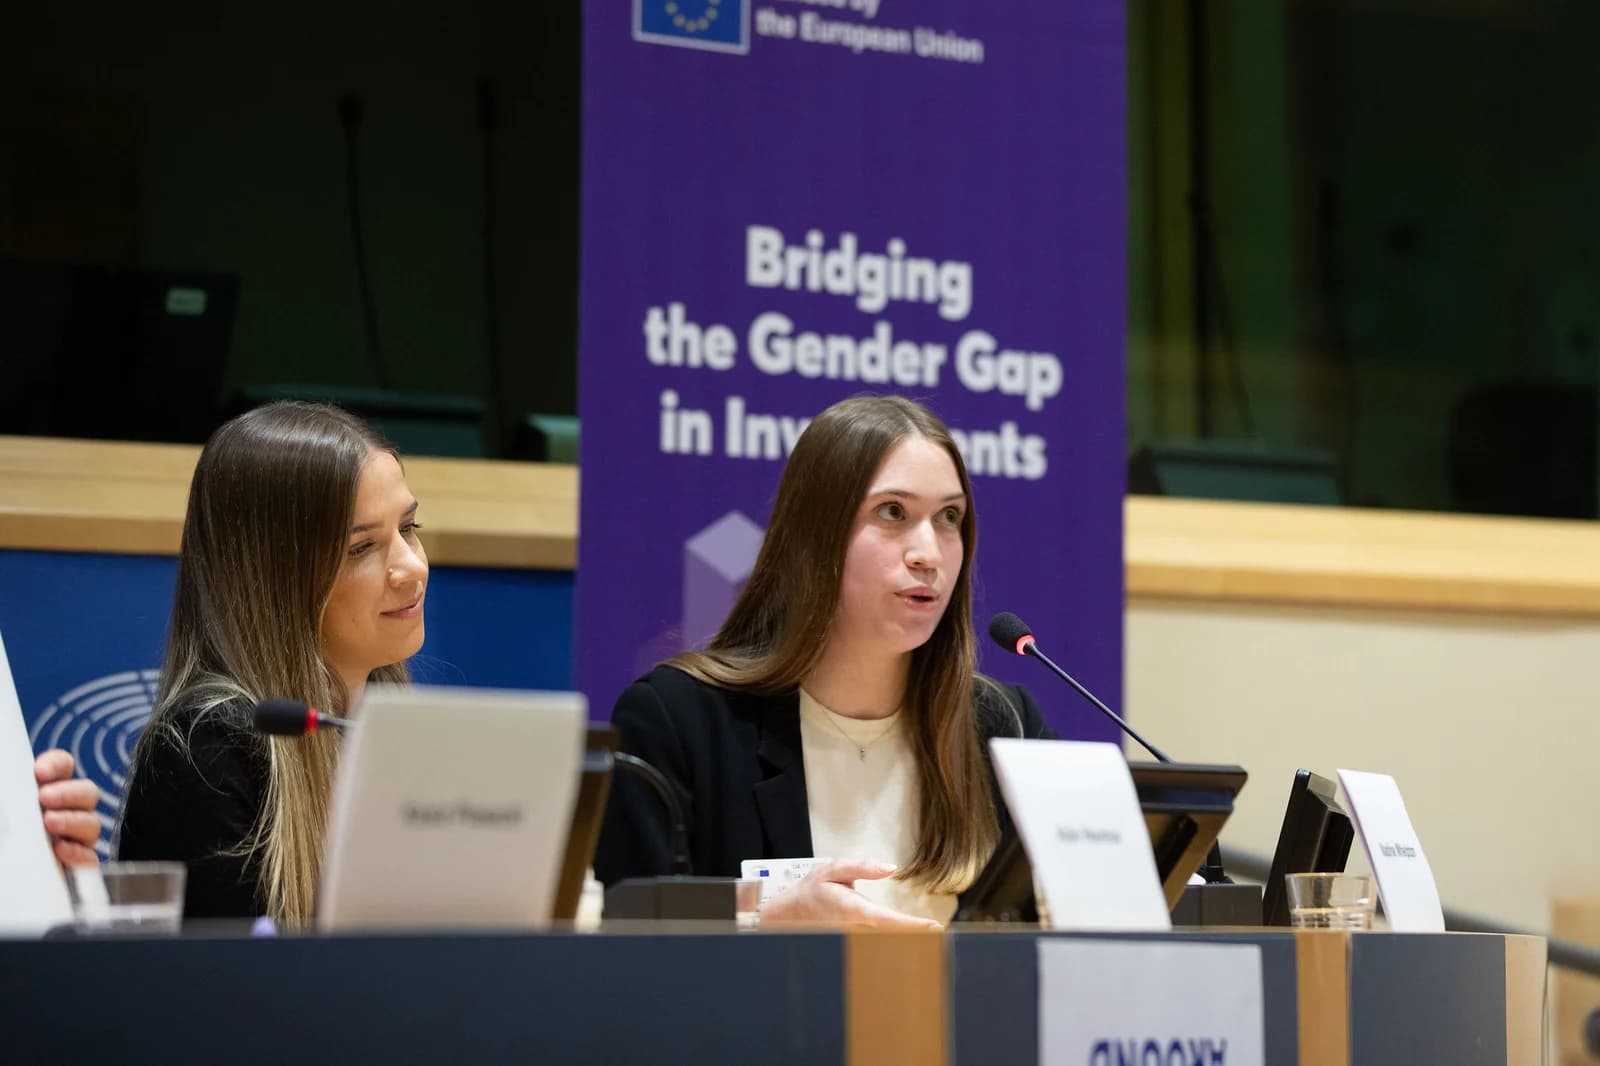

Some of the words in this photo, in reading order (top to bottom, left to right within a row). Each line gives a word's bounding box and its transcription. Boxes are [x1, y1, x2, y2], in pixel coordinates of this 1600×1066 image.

[756, 8, 797, 39] the
[801, 12, 912, 54] European
[914, 27, 985, 64] Union
[746, 225, 973, 321] Bridging
[644, 303, 737, 370] the
[748, 312, 947, 387] Gender
[955, 330, 1063, 411] Gap
[660, 390, 713, 456] in
